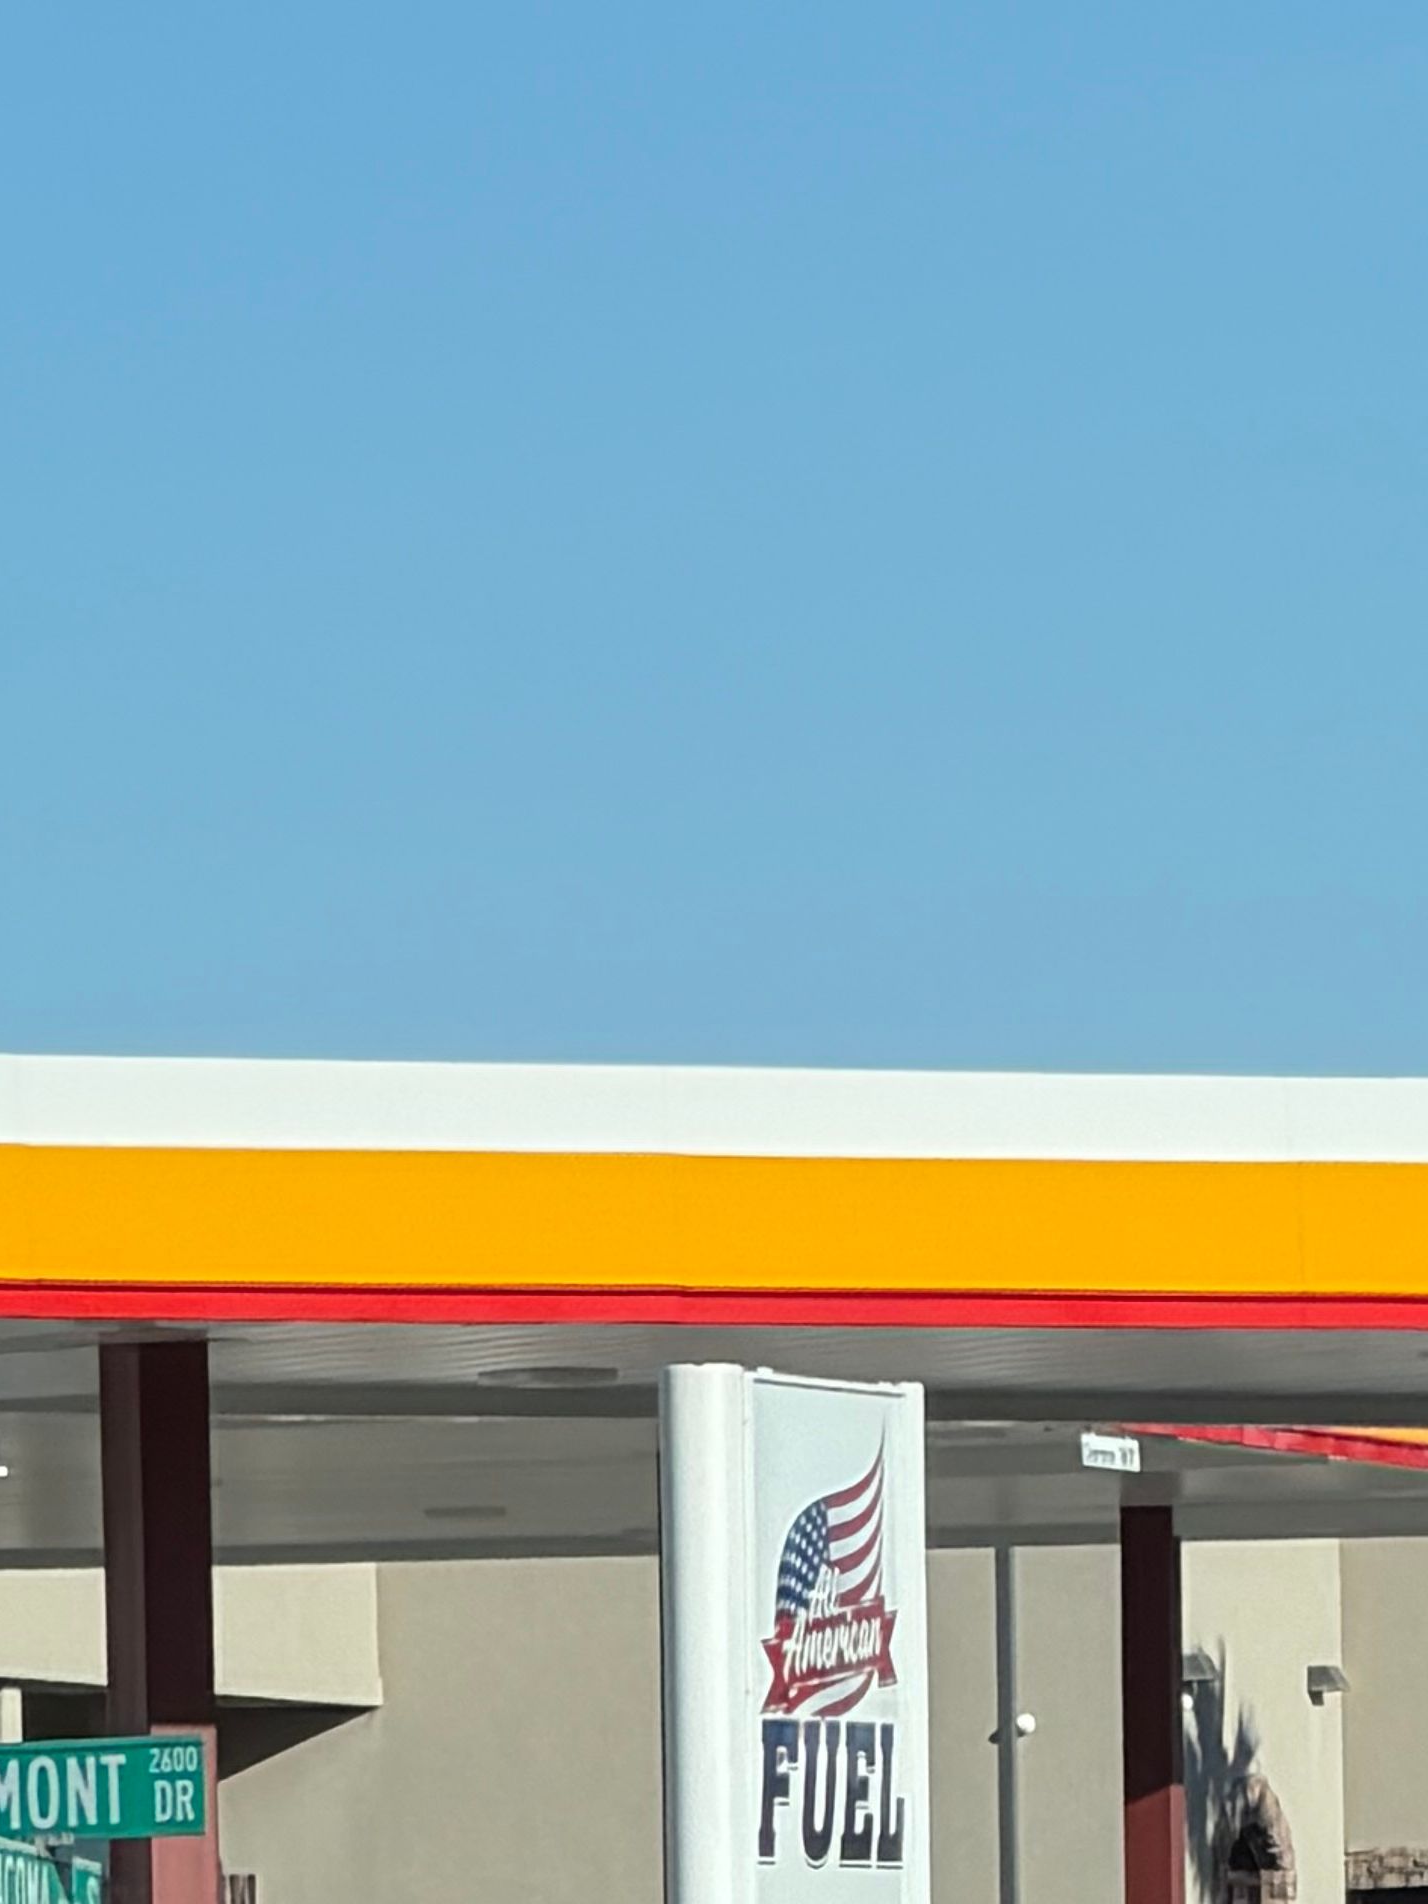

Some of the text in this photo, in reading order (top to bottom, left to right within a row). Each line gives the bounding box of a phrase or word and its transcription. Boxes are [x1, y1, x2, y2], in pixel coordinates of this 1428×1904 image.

[809, 1563, 840, 1625] All
[781, 1606, 882, 1683] American
[149, 1746, 198, 1774] 2600
[154, 1779, 196, 1823] DR
[756, 1716, 905, 1869] FUEL
